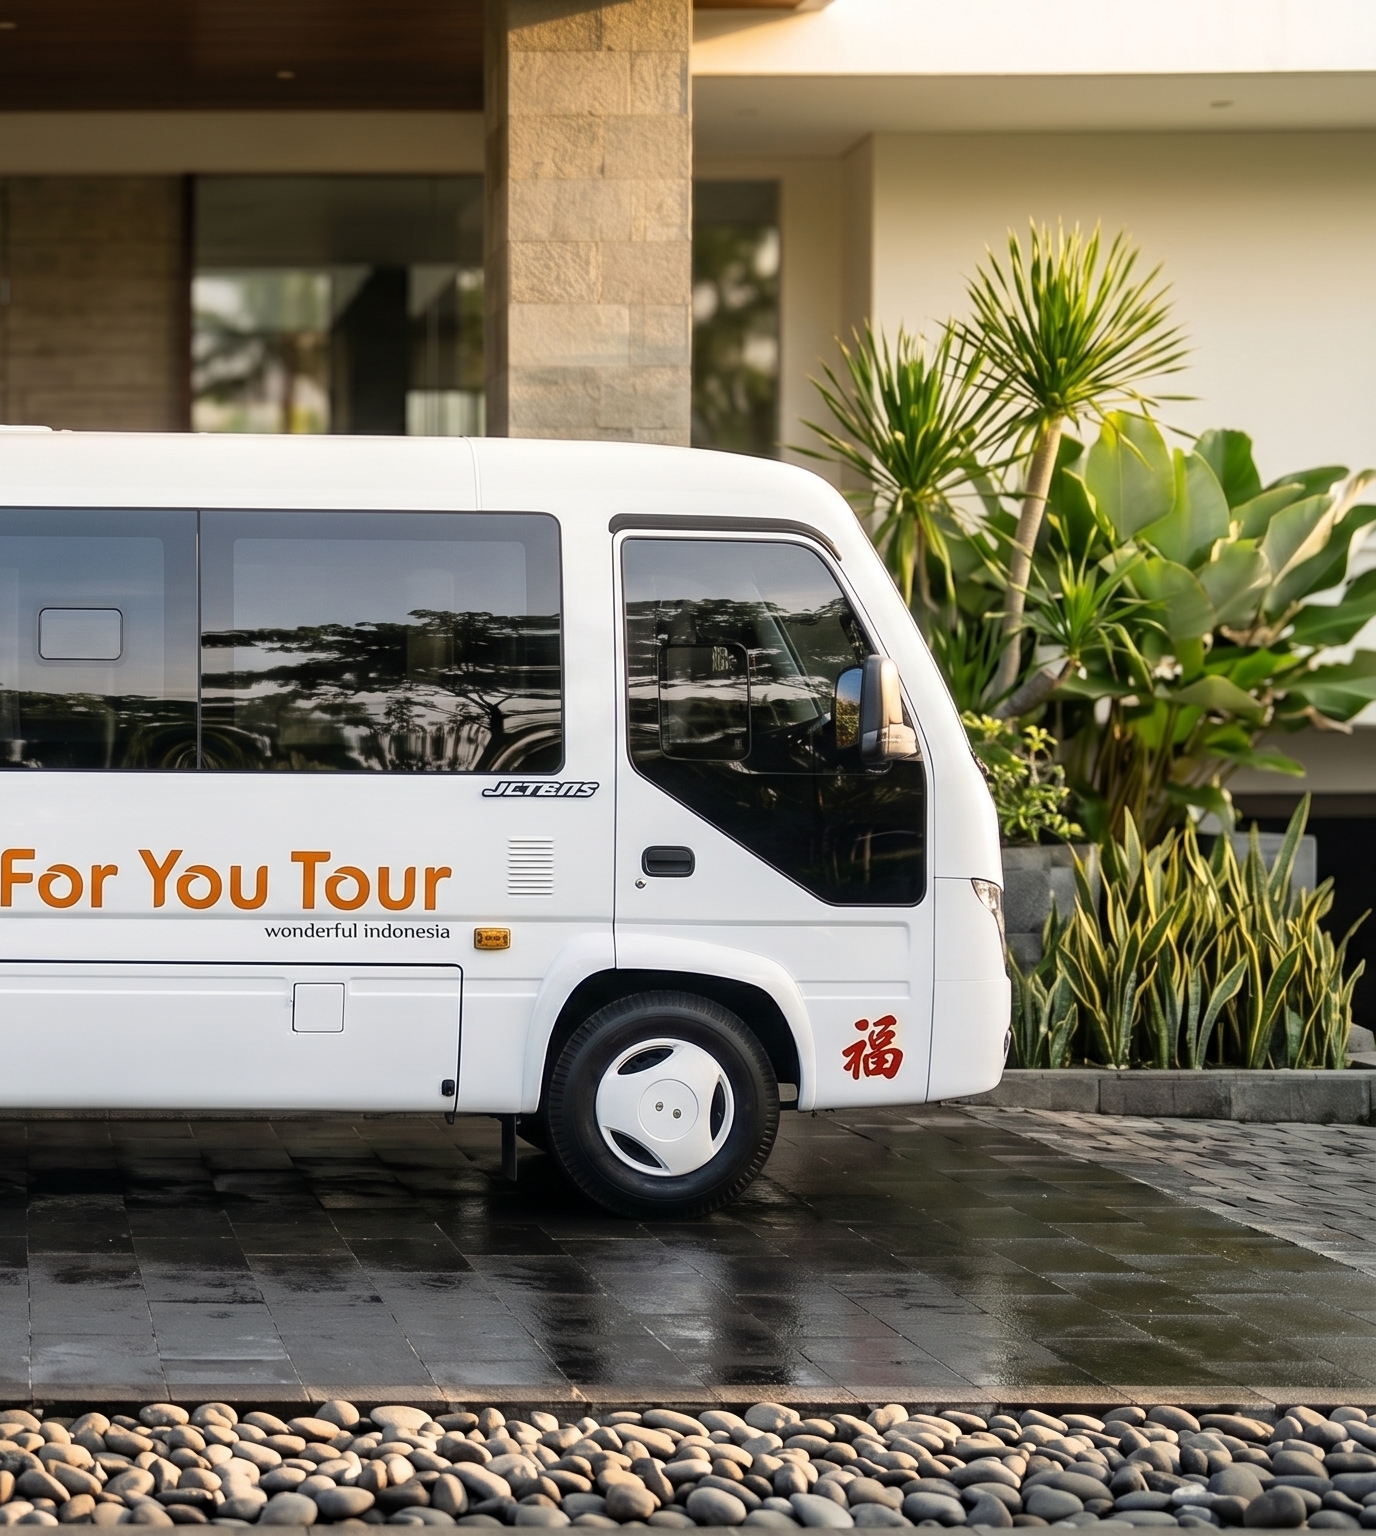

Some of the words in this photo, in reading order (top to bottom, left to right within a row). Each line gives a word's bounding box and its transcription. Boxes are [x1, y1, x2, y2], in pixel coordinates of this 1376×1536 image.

[0, 848, 119, 909] For
[138, 849, 268, 910] You
[290, 851, 452, 911] Tour
[264, 922, 358, 939] wonderful
[363, 923, 451, 939] indonesia
[841, 1014, 904, 1081] 福
